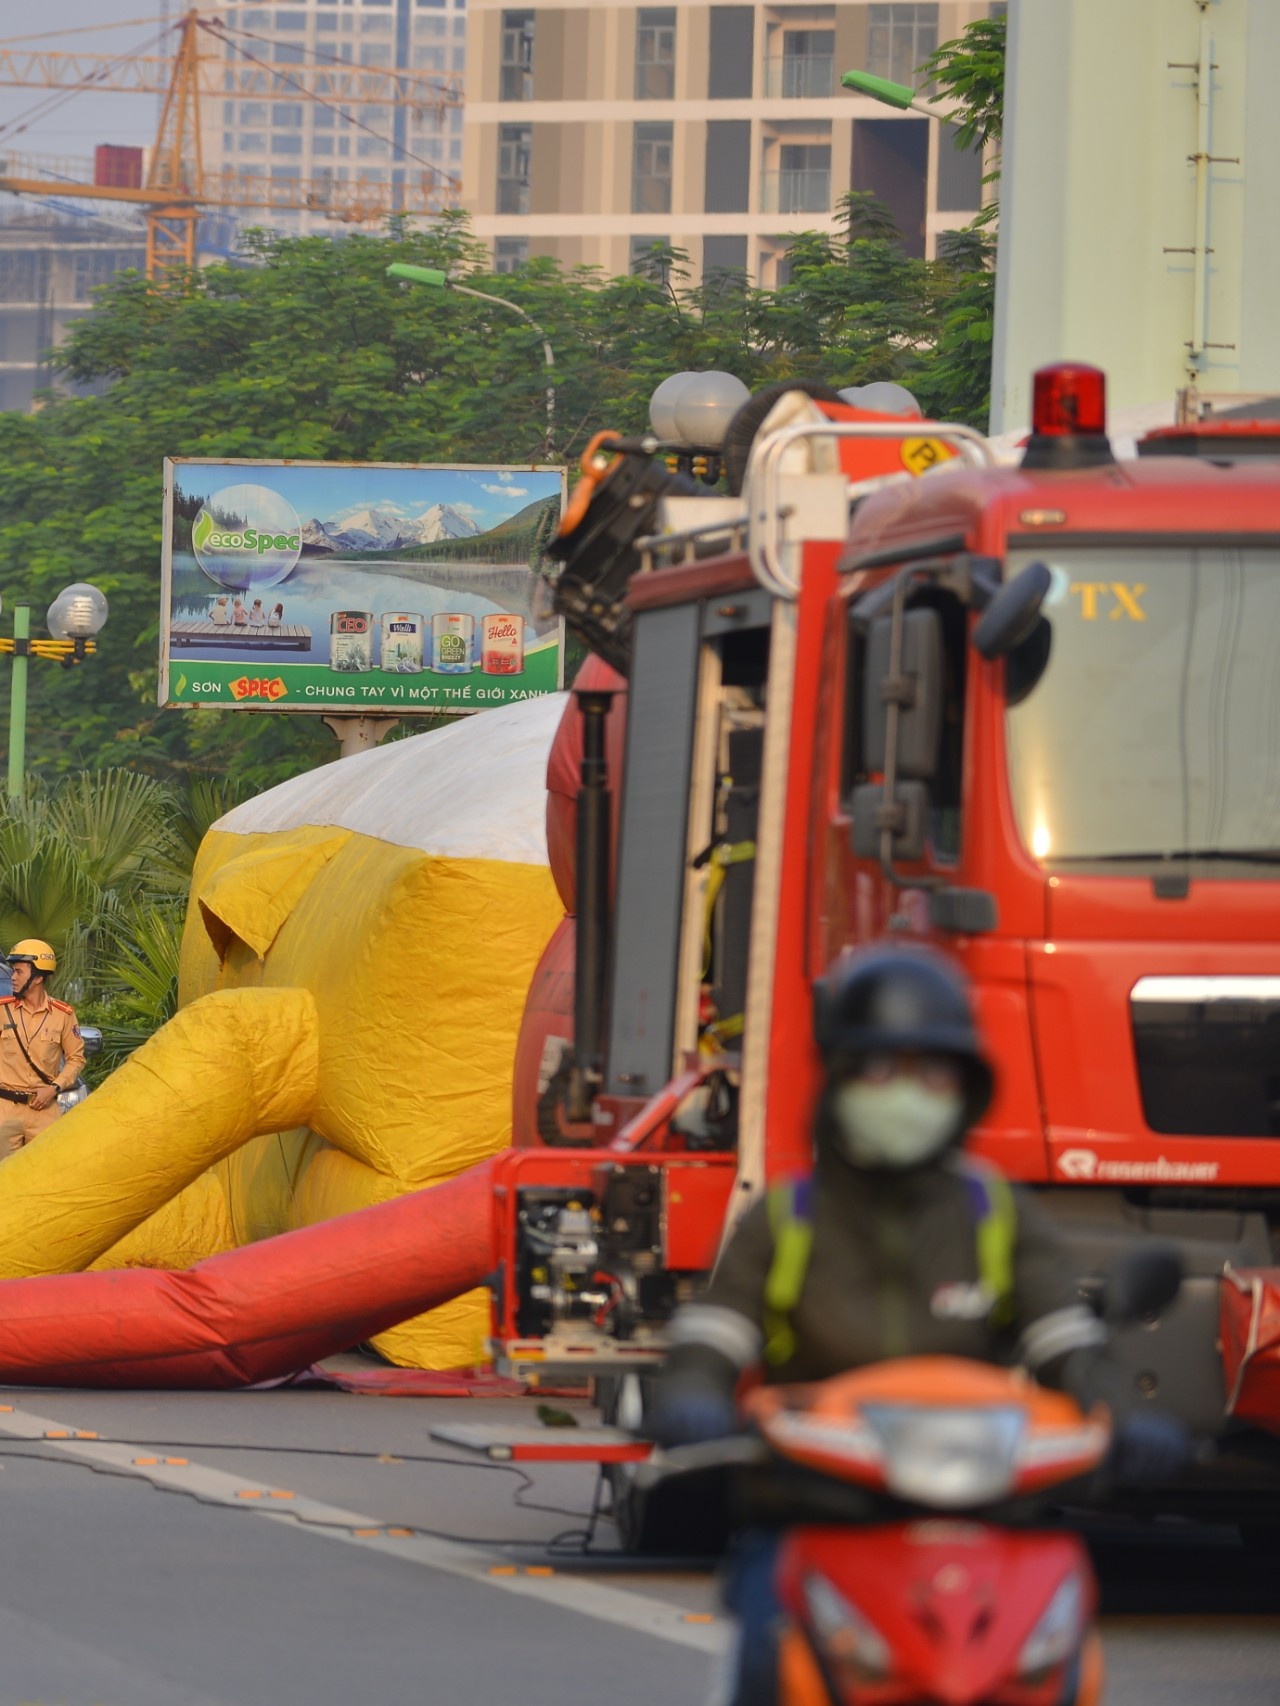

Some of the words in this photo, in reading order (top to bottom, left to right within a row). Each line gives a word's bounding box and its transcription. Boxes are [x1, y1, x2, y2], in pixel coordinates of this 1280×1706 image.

[209, 529, 300, 555] ecoSpec
[337, 617, 367, 633] CEO
[488, 624, 517, 640] Hello
[441, 635, 460, 648] GO
[441, 647, 465, 655] GREEN
[192, 681, 222, 693] SƠN
[237, 679, 280, 698] SPEC
[305, 685, 355, 697] CHUNG
[361, 686, 386, 697] TAY
[391, 685, 405, 698] VÌ
[409, 688, 439, 700] MỘT
[443, 685, 471, 699] THẾ
[476, 687, 505, 699] GIỚI
